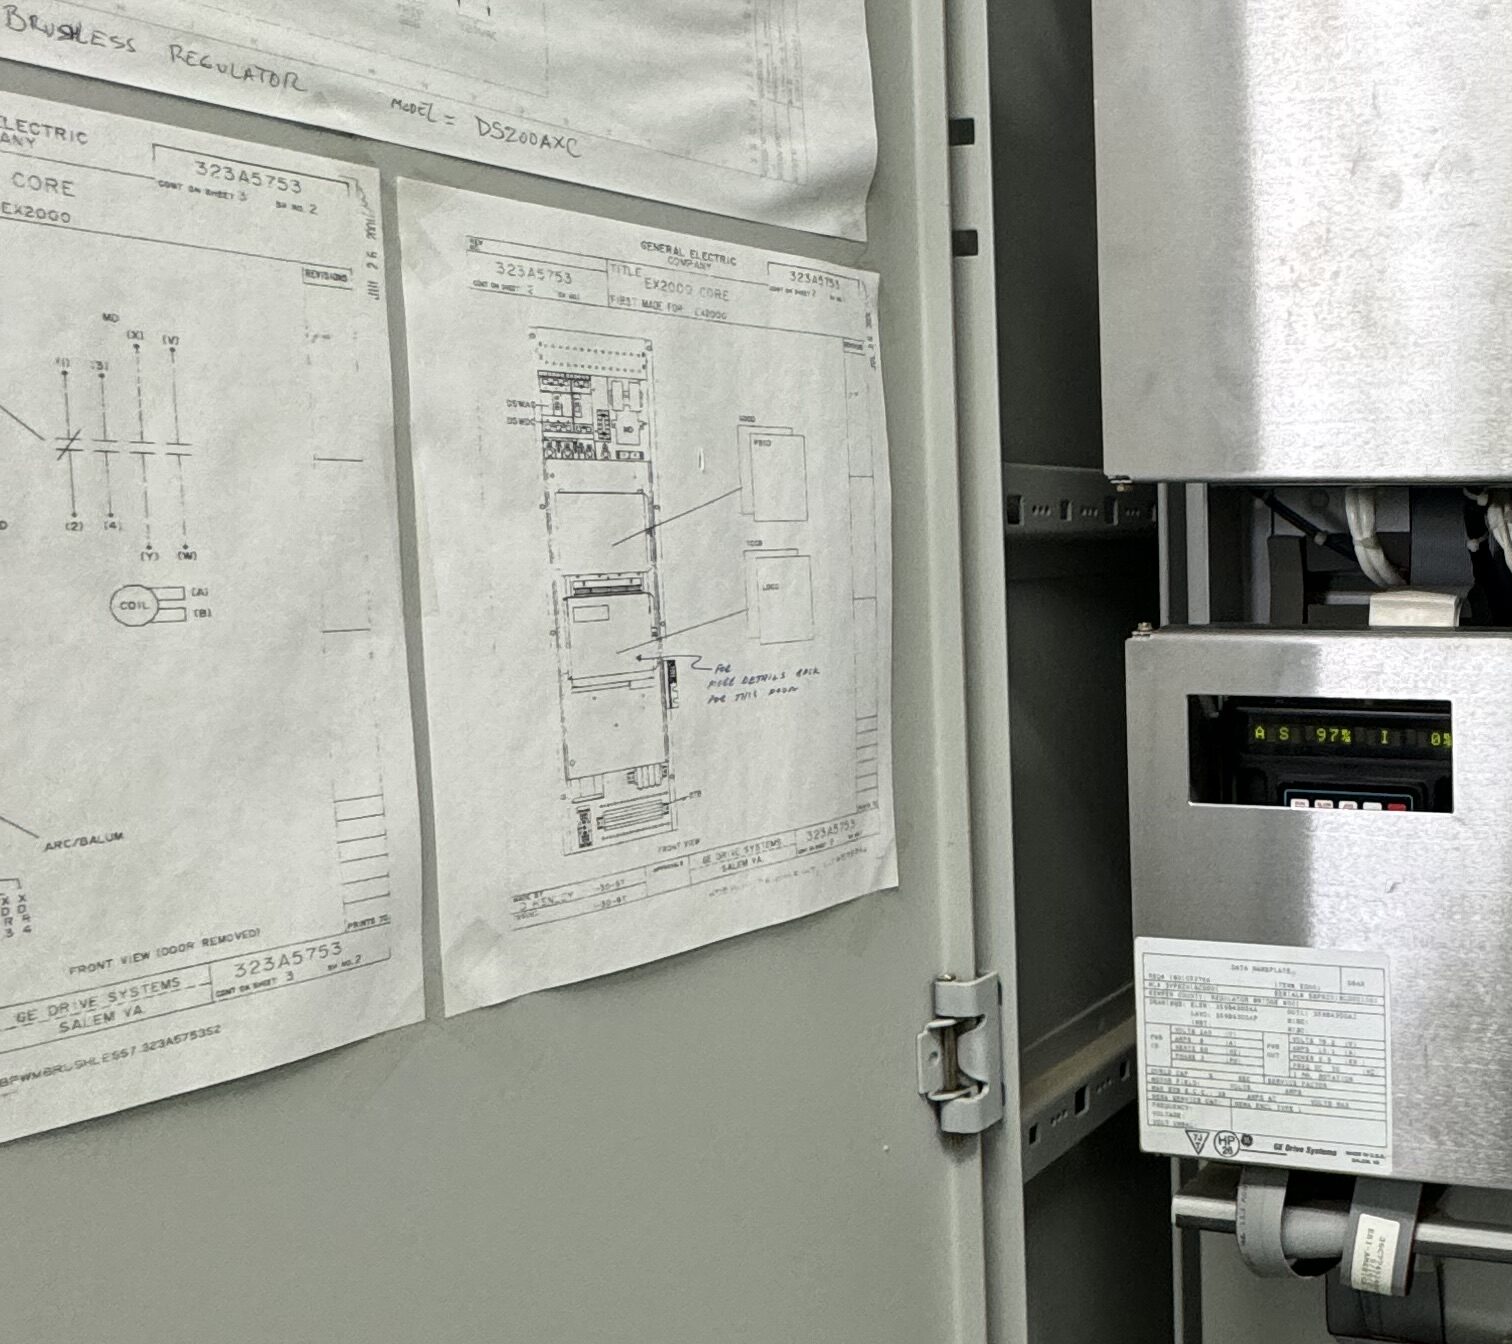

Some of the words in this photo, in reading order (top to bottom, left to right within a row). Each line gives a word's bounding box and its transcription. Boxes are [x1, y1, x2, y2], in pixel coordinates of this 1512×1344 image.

[169, 43, 308, 92] REGULATOR
[474, 115, 582, 159] DS200AXC
[12, 171, 76, 198] CORE
[195, 160, 303, 194] 323A5753
[640, 239, 685, 260] GENERAL
[689, 249, 738, 268] ELECTRIC
[610, 263, 643, 279] TITLE
[699, 285, 731, 302] CORE
[119, 600, 150, 611] COIL
[1279, 726, 1289, 741] S
[1315, 727, 1351, 743] 97%
[68, 958, 113, 976] FRONT
[120, 951, 151, 966] VIEW
[233, 941, 344, 979] 323A5753
[16, 1008, 39, 1024] GE
[47, 995, 98, 1018] DRIVE
[107, 976, 182, 1004] SYSTEMS
[58, 1010, 116, 1034] SALEM
[124, 1004, 145, 1018] VA
[1218, 1135, 1236, 1147] HP
[1285, 1144, 1305, 1154] Drive
[1306, 1145, 1337, 1157] Systems
